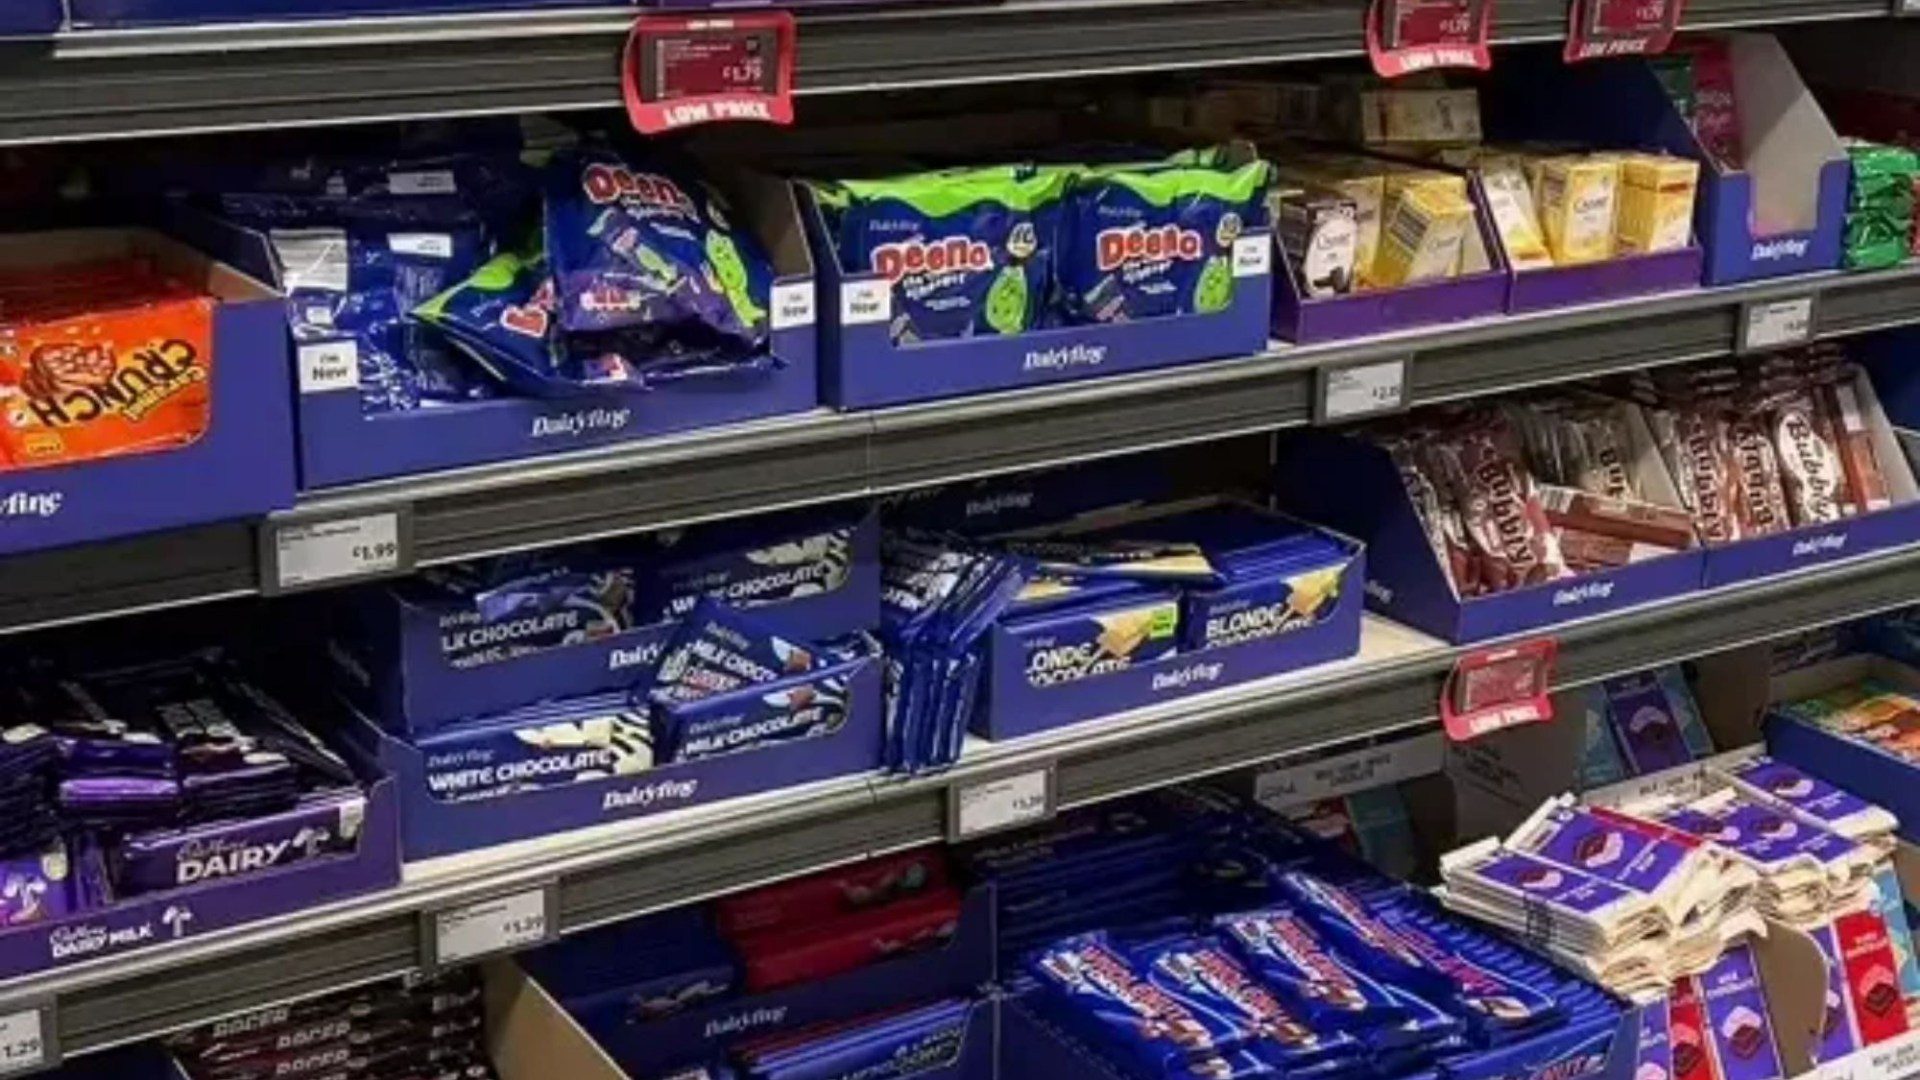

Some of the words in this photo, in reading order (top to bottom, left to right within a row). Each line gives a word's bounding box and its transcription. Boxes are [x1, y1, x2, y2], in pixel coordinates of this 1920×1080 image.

[662, 103, 708, 126] LOW
[712, 101, 771, 121] PRICE
[312, 366, 348, 381] New
[1023, 344, 1108, 371] Dairyfine
[28, 339, 198, 428] CRUNCH
[530, 407, 632, 438] Dairyfine
[1786, 415, 1833, 521] Bubbly
[1478, 460, 1535, 566] Bubbly
[352, 541, 397, 561] £1.99
[728, 562, 825, 599] CHOCOLATE
[469, 609, 580, 647] CHOCOLATE
[1205, 603, 1284, 639] BLONDE
[1153, 664, 1224, 691] Dairyfine
[686, 734, 726, 754] MILK
[728, 706, 823, 745] CHOCOLATE
[428, 768, 494, 791] WHITE
[497, 748, 611, 782] CHOCOLATE
[604, 779, 699, 809] Dairyfine
[177, 838, 291, 884] DAIRY
[52, 935, 106, 960] DAIRY
[109, 922, 153, 947] MILK
